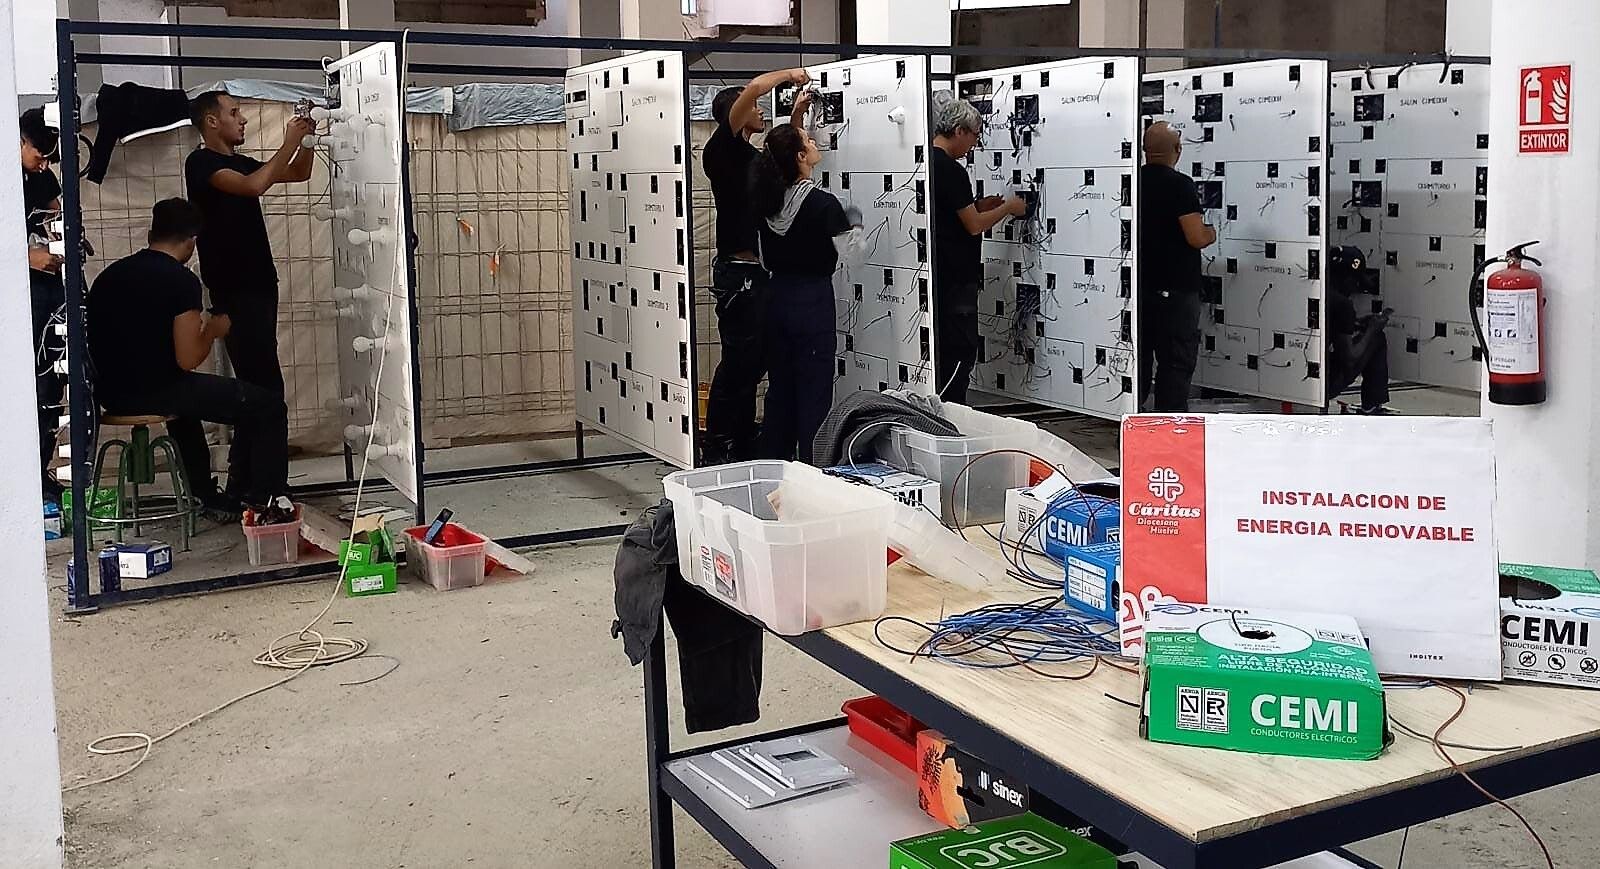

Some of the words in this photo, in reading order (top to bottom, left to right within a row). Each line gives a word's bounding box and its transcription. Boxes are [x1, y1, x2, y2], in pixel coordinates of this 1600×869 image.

[1521, 133, 1567, 149] EXTINTOR
[1128, 502, 1201, 518] Cáritas
[1262, 490, 1410, 510] INSTALACION
[1417, 495, 1446, 511] DE
[1047, 515, 1088, 546] CEMI
[1136, 517, 1179, 527] Diocesana
[1149, 526, 1179, 535] Huelva
[1237, 518, 1332, 537] ENERGIA
[1339, 522, 1475, 542] RENOVABLE
[1501, 614, 1589, 648] CEMI
[1503, 641, 1548, 652] ONDUCTORES
[1217, 653, 1260, 661] ALTA
[1264, 656, 1369, 675] SEGURIDAD
[1251, 694, 1358, 733] CEMI
[1250, 728, 1310, 740] CONDUCTORES
[1311, 734, 1358, 744] ELECTRICOS
[992, 780, 1024, 808] sinex
[957, 836, 1052, 867] BJC
